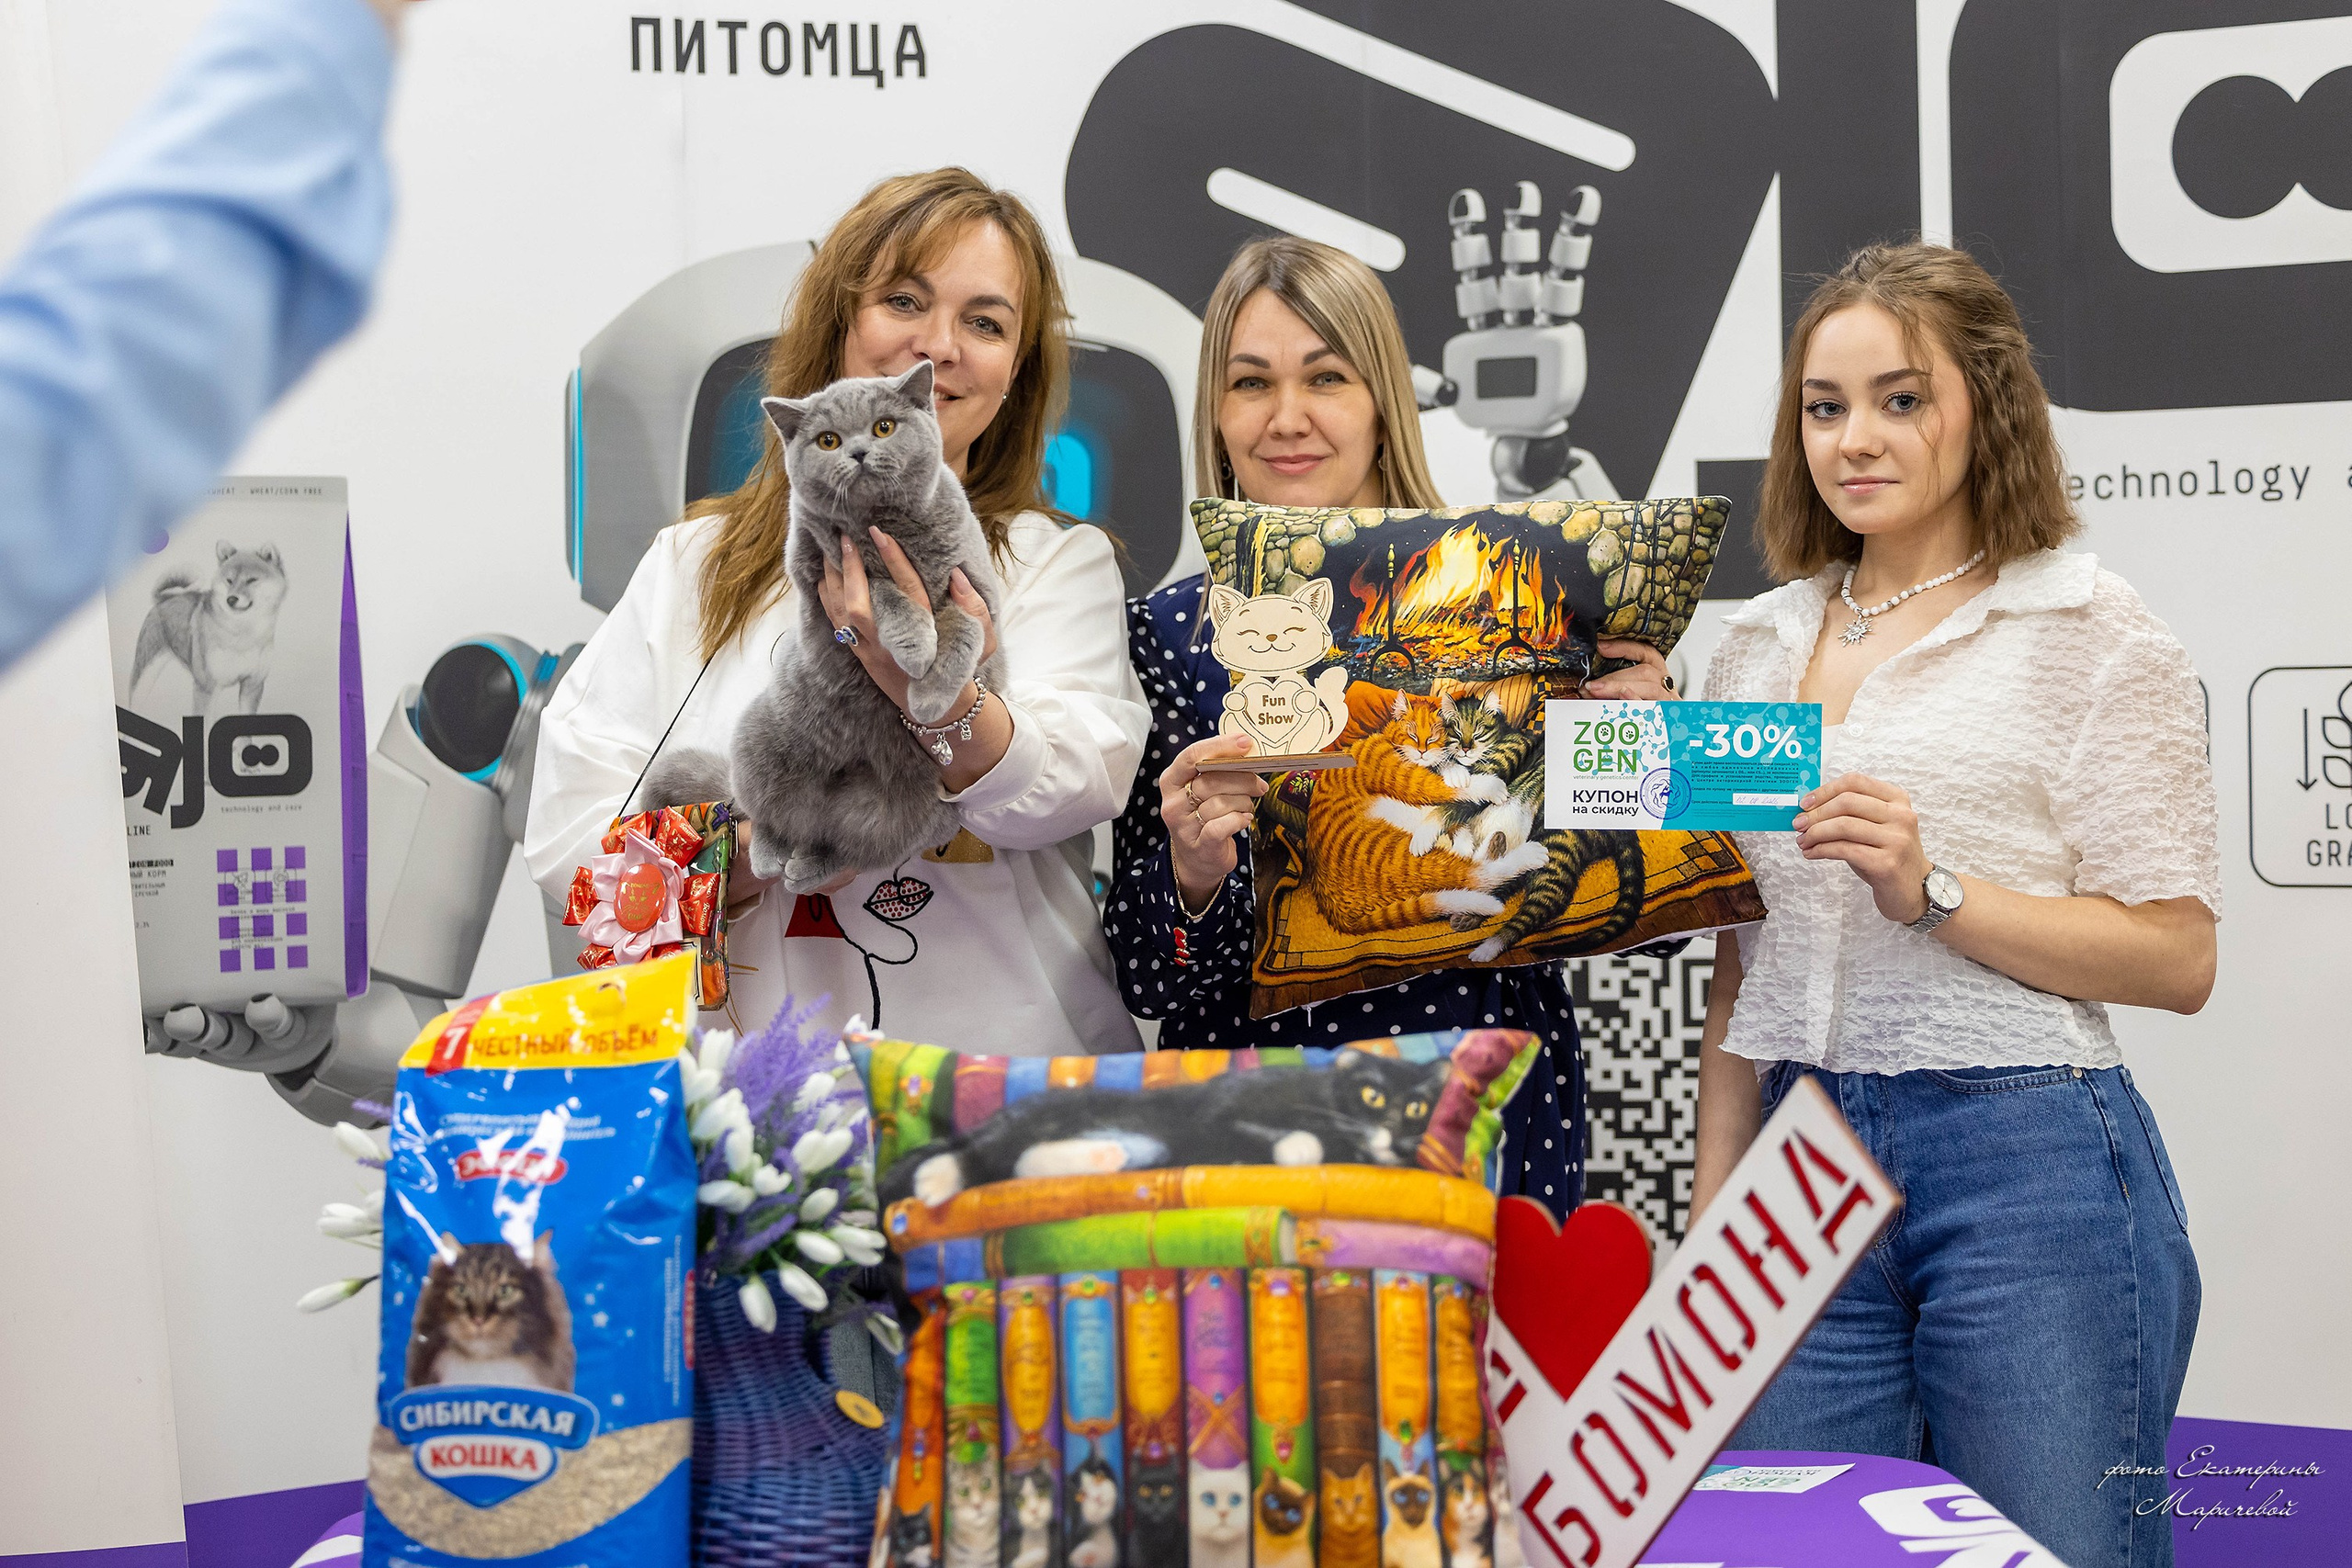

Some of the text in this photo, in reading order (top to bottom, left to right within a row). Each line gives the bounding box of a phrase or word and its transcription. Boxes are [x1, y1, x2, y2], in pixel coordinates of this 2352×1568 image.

[631, 17, 926, 88] ПИТОМЦА
[2067, 460, 2311, 502] echnology
[1262, 695, 1285, 706] Fun
[1258, 713, 1294, 725] Show
[1574, 721, 1640, 746] ZOO
[1689, 724, 1803, 759] -30%
[1573, 748, 1637, 773] GEN
[1573, 790, 1638, 803] КУПОН
[1591, 807, 1639, 817] скидку
[472, 1028, 574, 1057] ЧЕСТНЫЙ
[1520, 1126, 1875, 1568] БОМОНД
[399, 1400, 576, 1437] СИБИРСКАЯ
[429, 1443, 538, 1472] КОШКА
